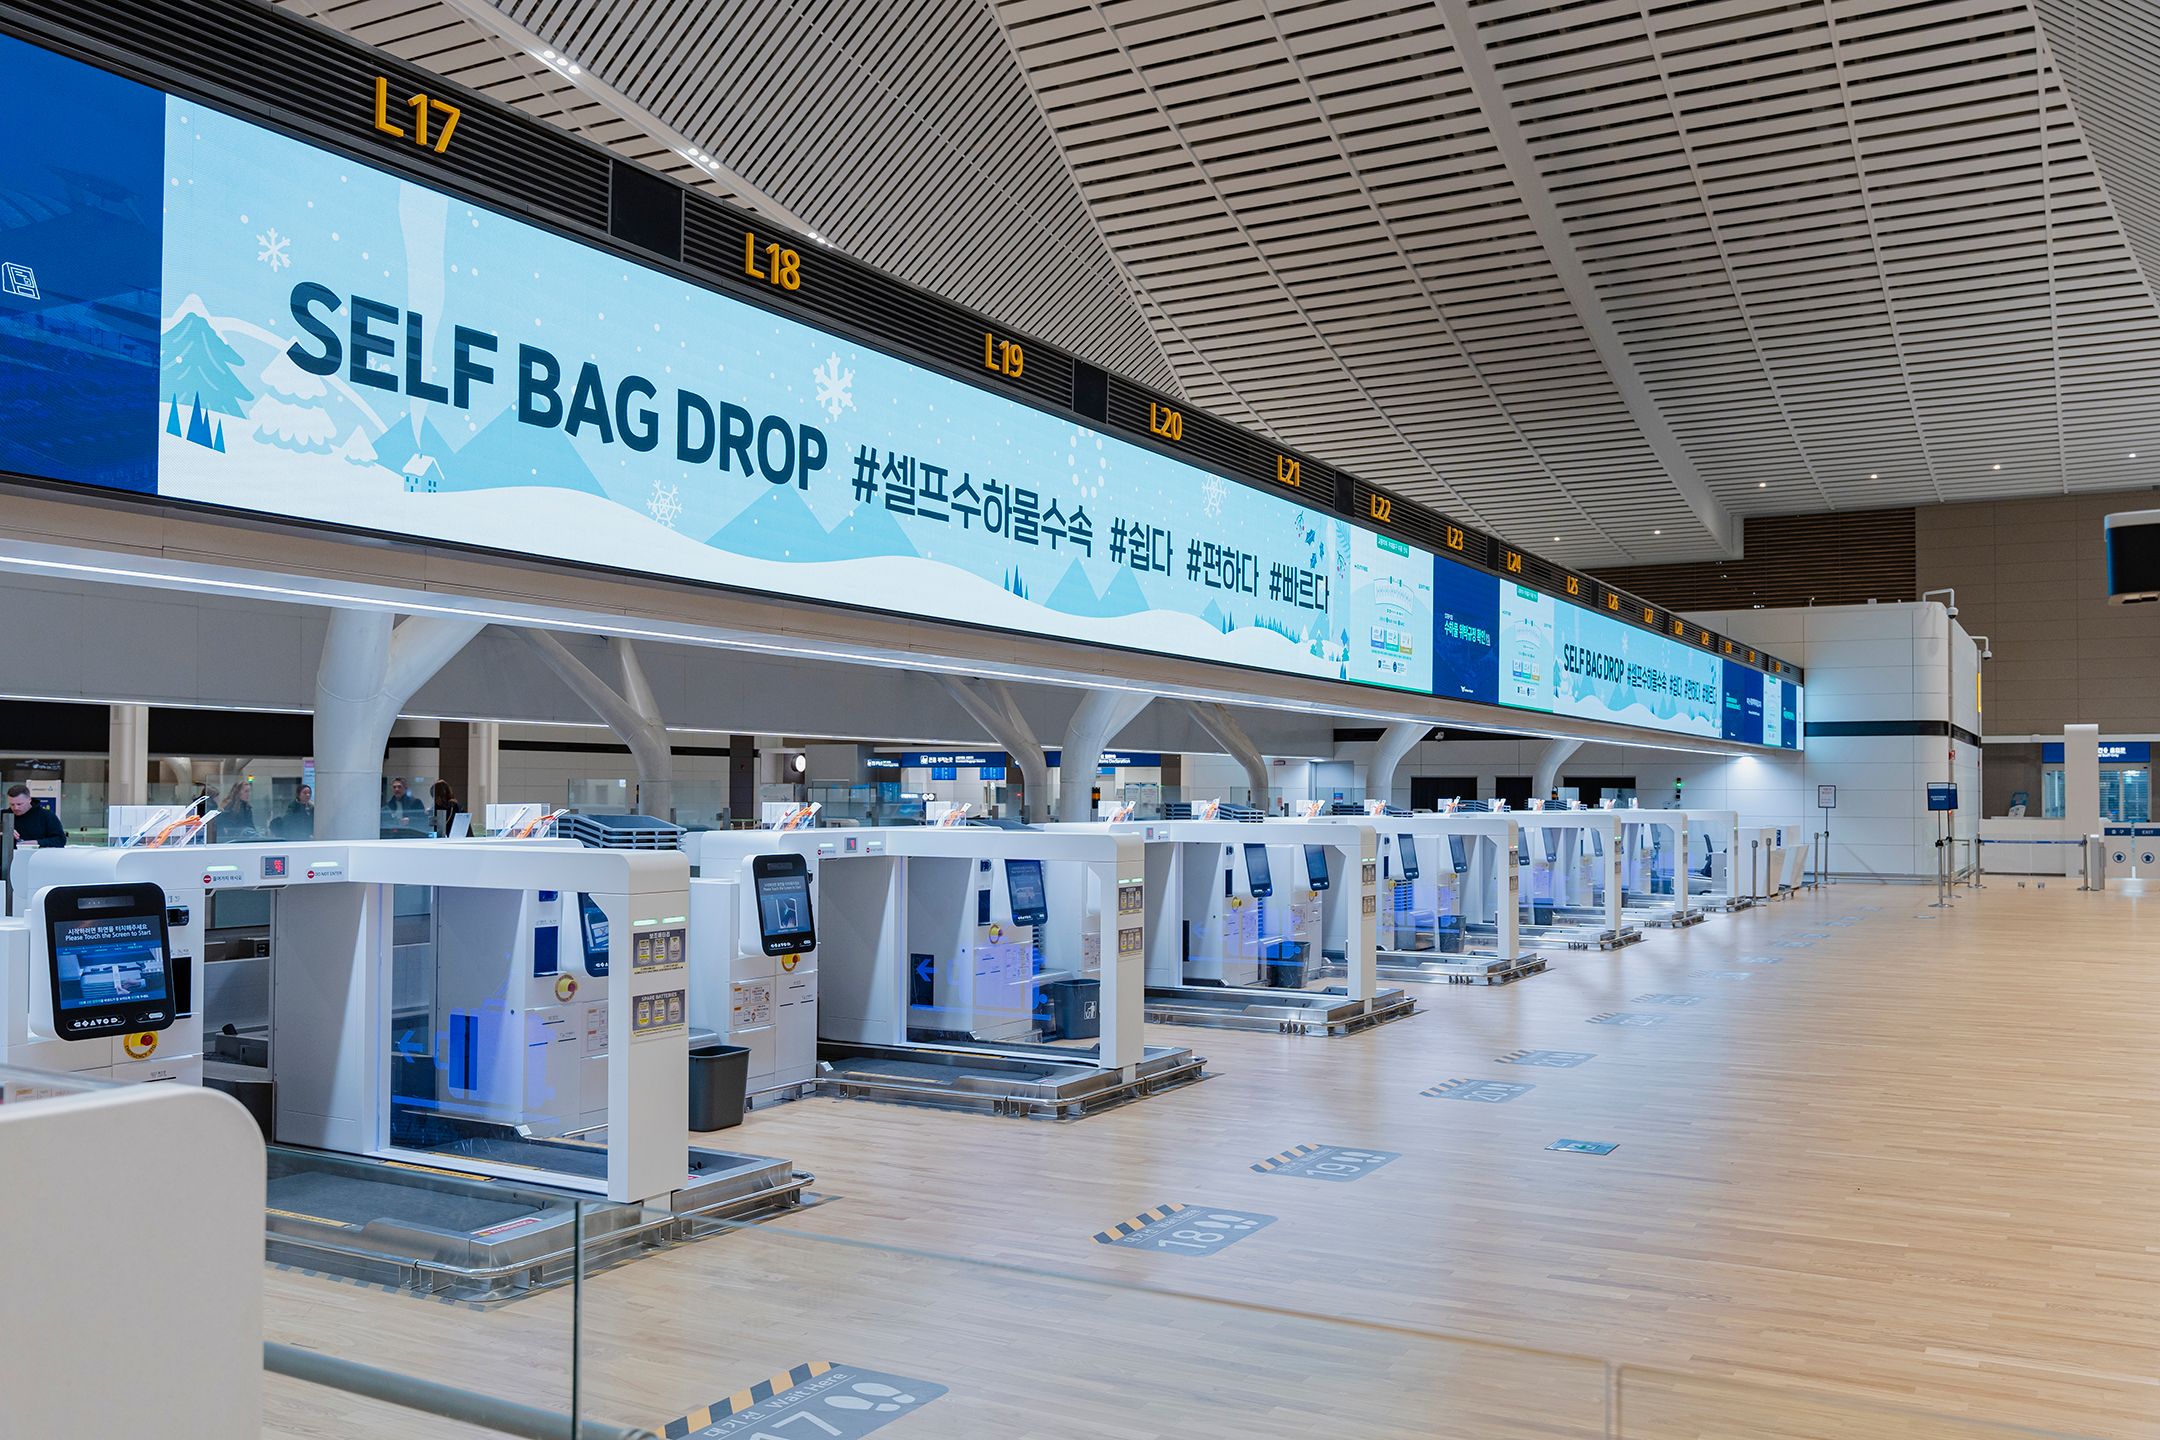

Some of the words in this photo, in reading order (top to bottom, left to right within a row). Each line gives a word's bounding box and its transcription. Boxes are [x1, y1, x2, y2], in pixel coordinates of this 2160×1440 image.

[375, 77, 460, 153] L17
[745, 232, 800, 290] L18
[985, 333, 1023, 378] L19
[1150, 403, 1182, 440] L20
[287, 282, 497, 408] SELF
[518, 343, 659, 452] BAG
[677, 388, 827, 490] DROP
[852, 444, 1092, 558] #셀프수하물수속
[1110, 517, 1173, 576] #쉽다
[1186, 539, 1259, 597] #편하다
[1269, 562, 1329, 614] #빠르다
[1277, 455, 1300, 487] L21
[1371, 494, 1390, 522] L22
[1448, 526, 1463, 550] L23
[1507, 552, 1521, 574] L24
[1566, 576, 1578, 595] L25
[1564, 644, 1584, 674] SELF
[1586, 650, 1602, 679] BAG
[1604, 656, 1624, 684] DROP
[656, 992, 677, 1000] BATTERIES
[1306, 1163, 1360, 1176] 19
[1159, 1230, 1224, 1249] 18
[765, 1390, 810, 1408] Wait
[804, 1373, 848, 1392] Here
